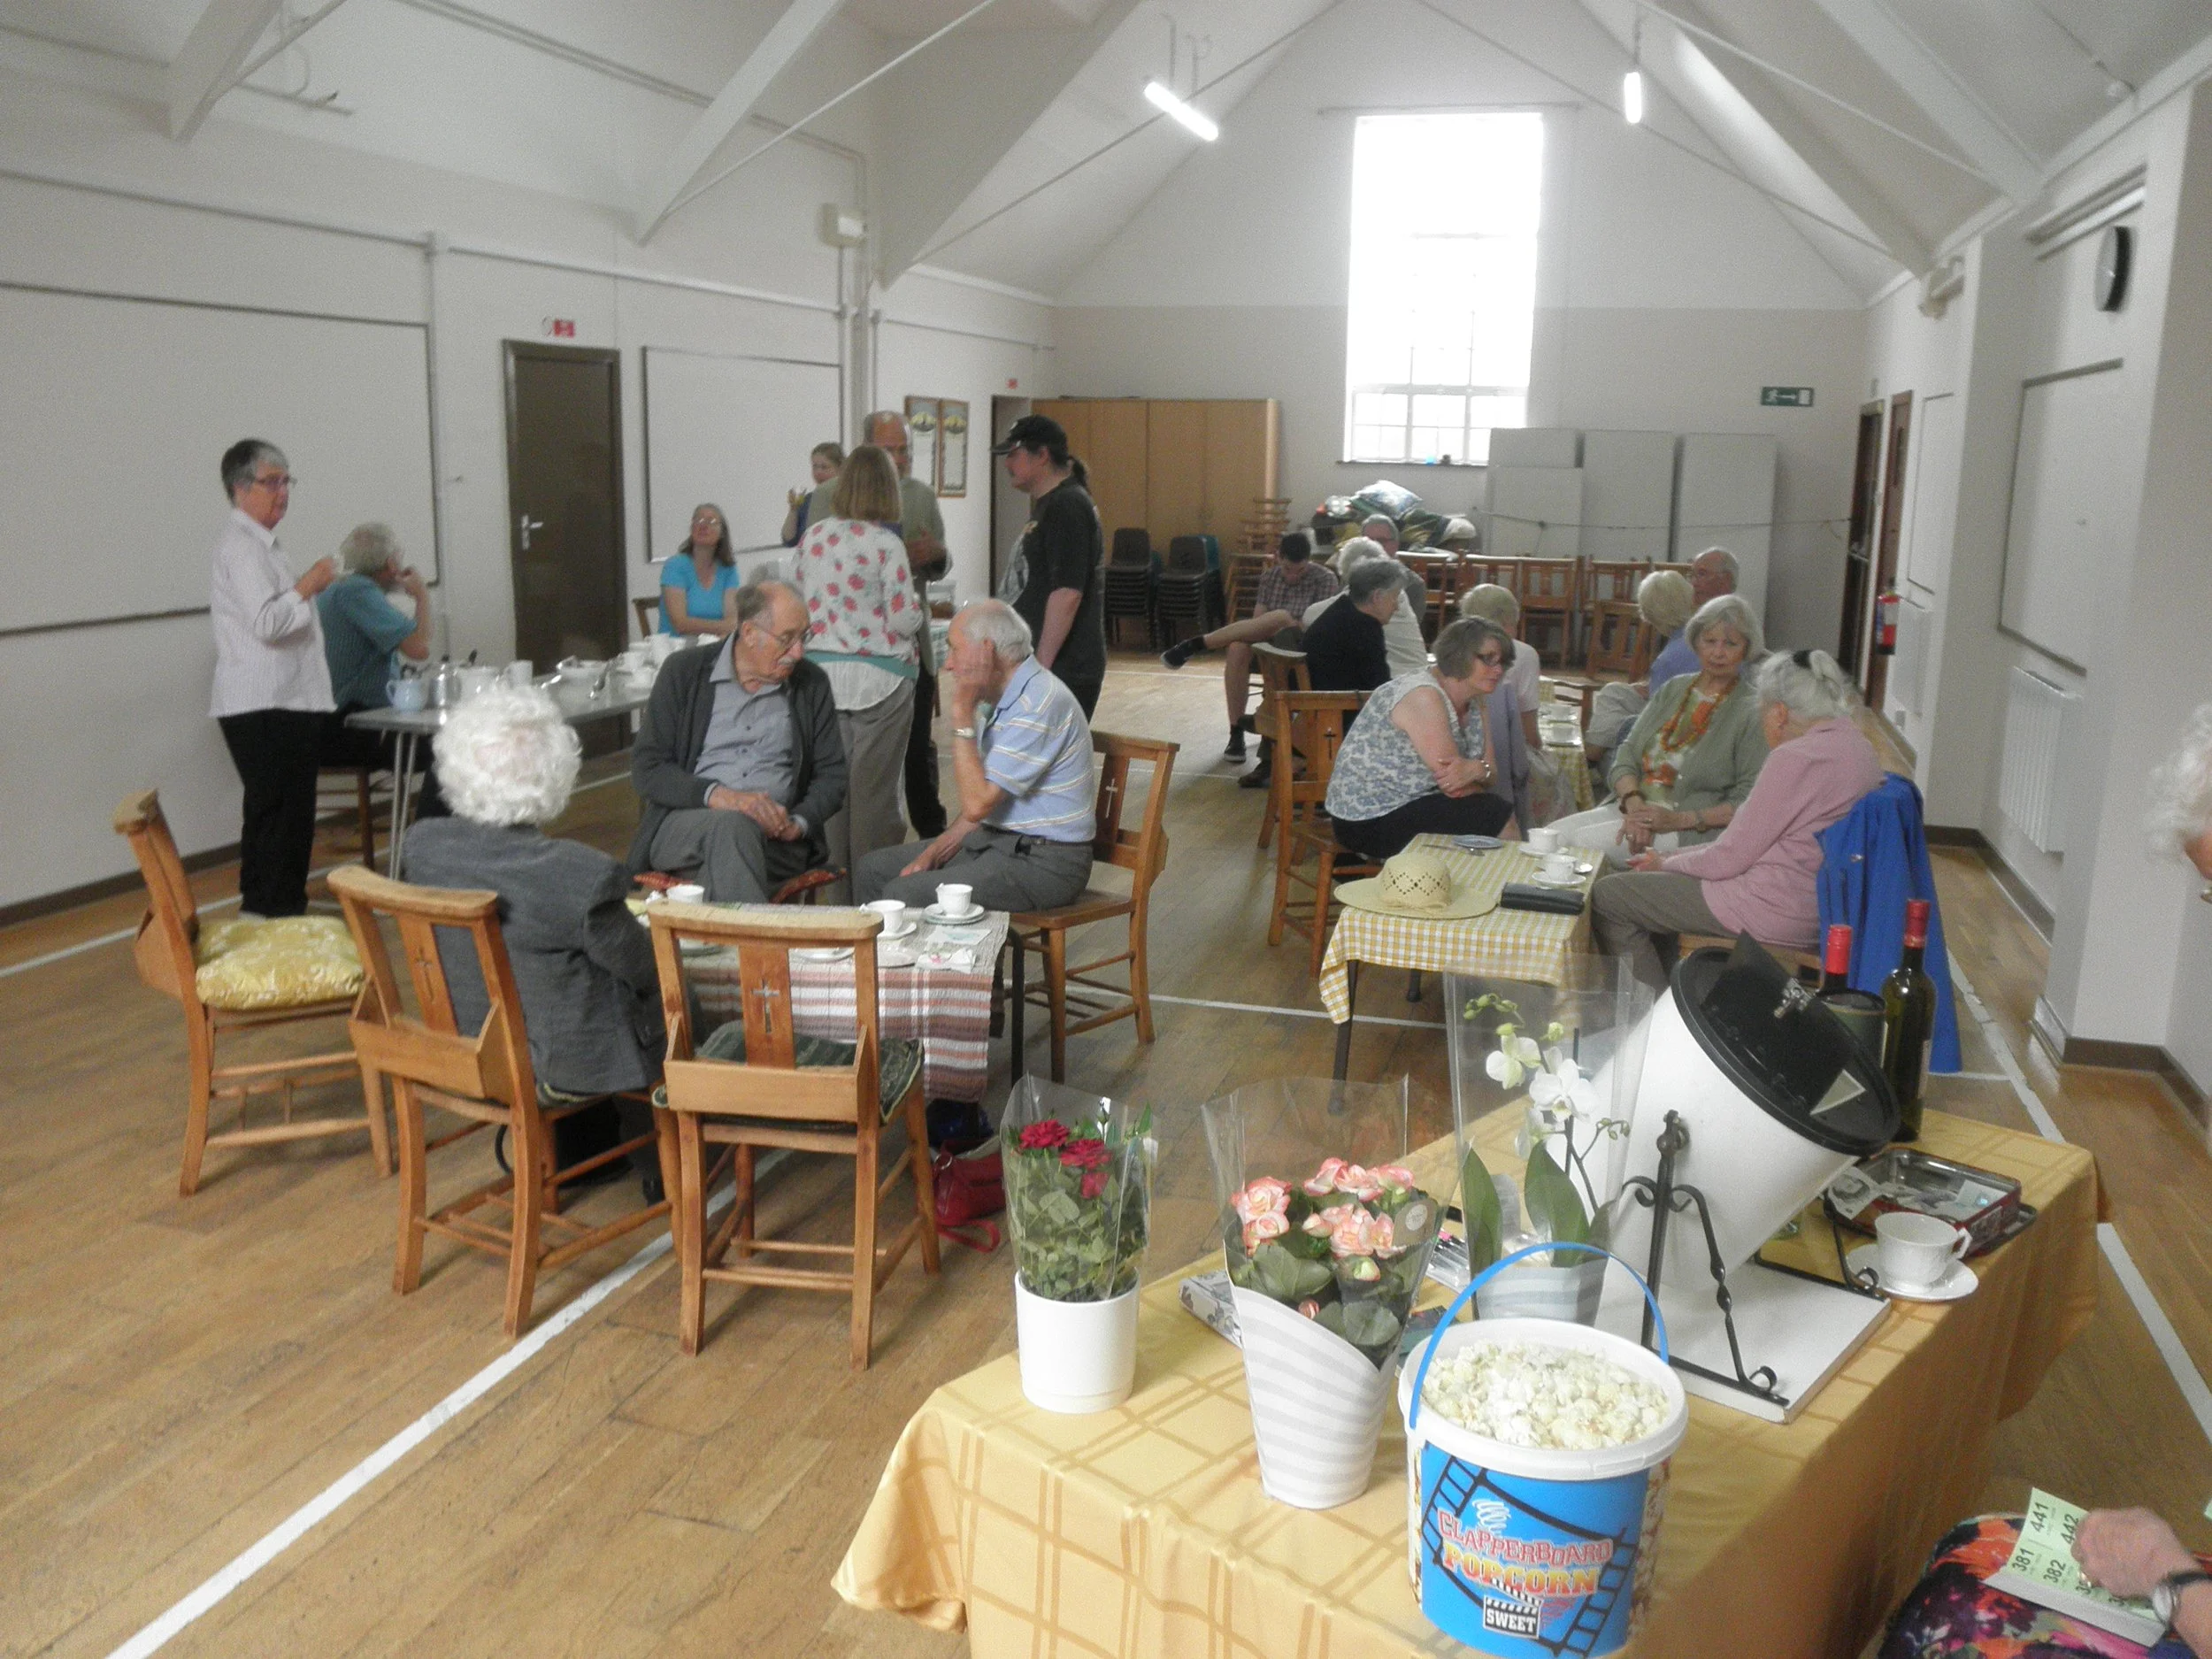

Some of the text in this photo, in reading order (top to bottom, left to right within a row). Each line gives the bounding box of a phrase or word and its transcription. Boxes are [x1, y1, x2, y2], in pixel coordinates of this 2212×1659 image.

[2030, 1502, 2049, 1532] 441
[2060, 1513, 2079, 1545] 442
[1438, 1509, 1613, 1568] CLAPPERBOARD
[1443, 1542, 1598, 1595] POPCORN
[2011, 1548, 2034, 1571] 381
[2043, 1559, 2067, 1583] 382
[1486, 1608, 1537, 1633] SWEET
